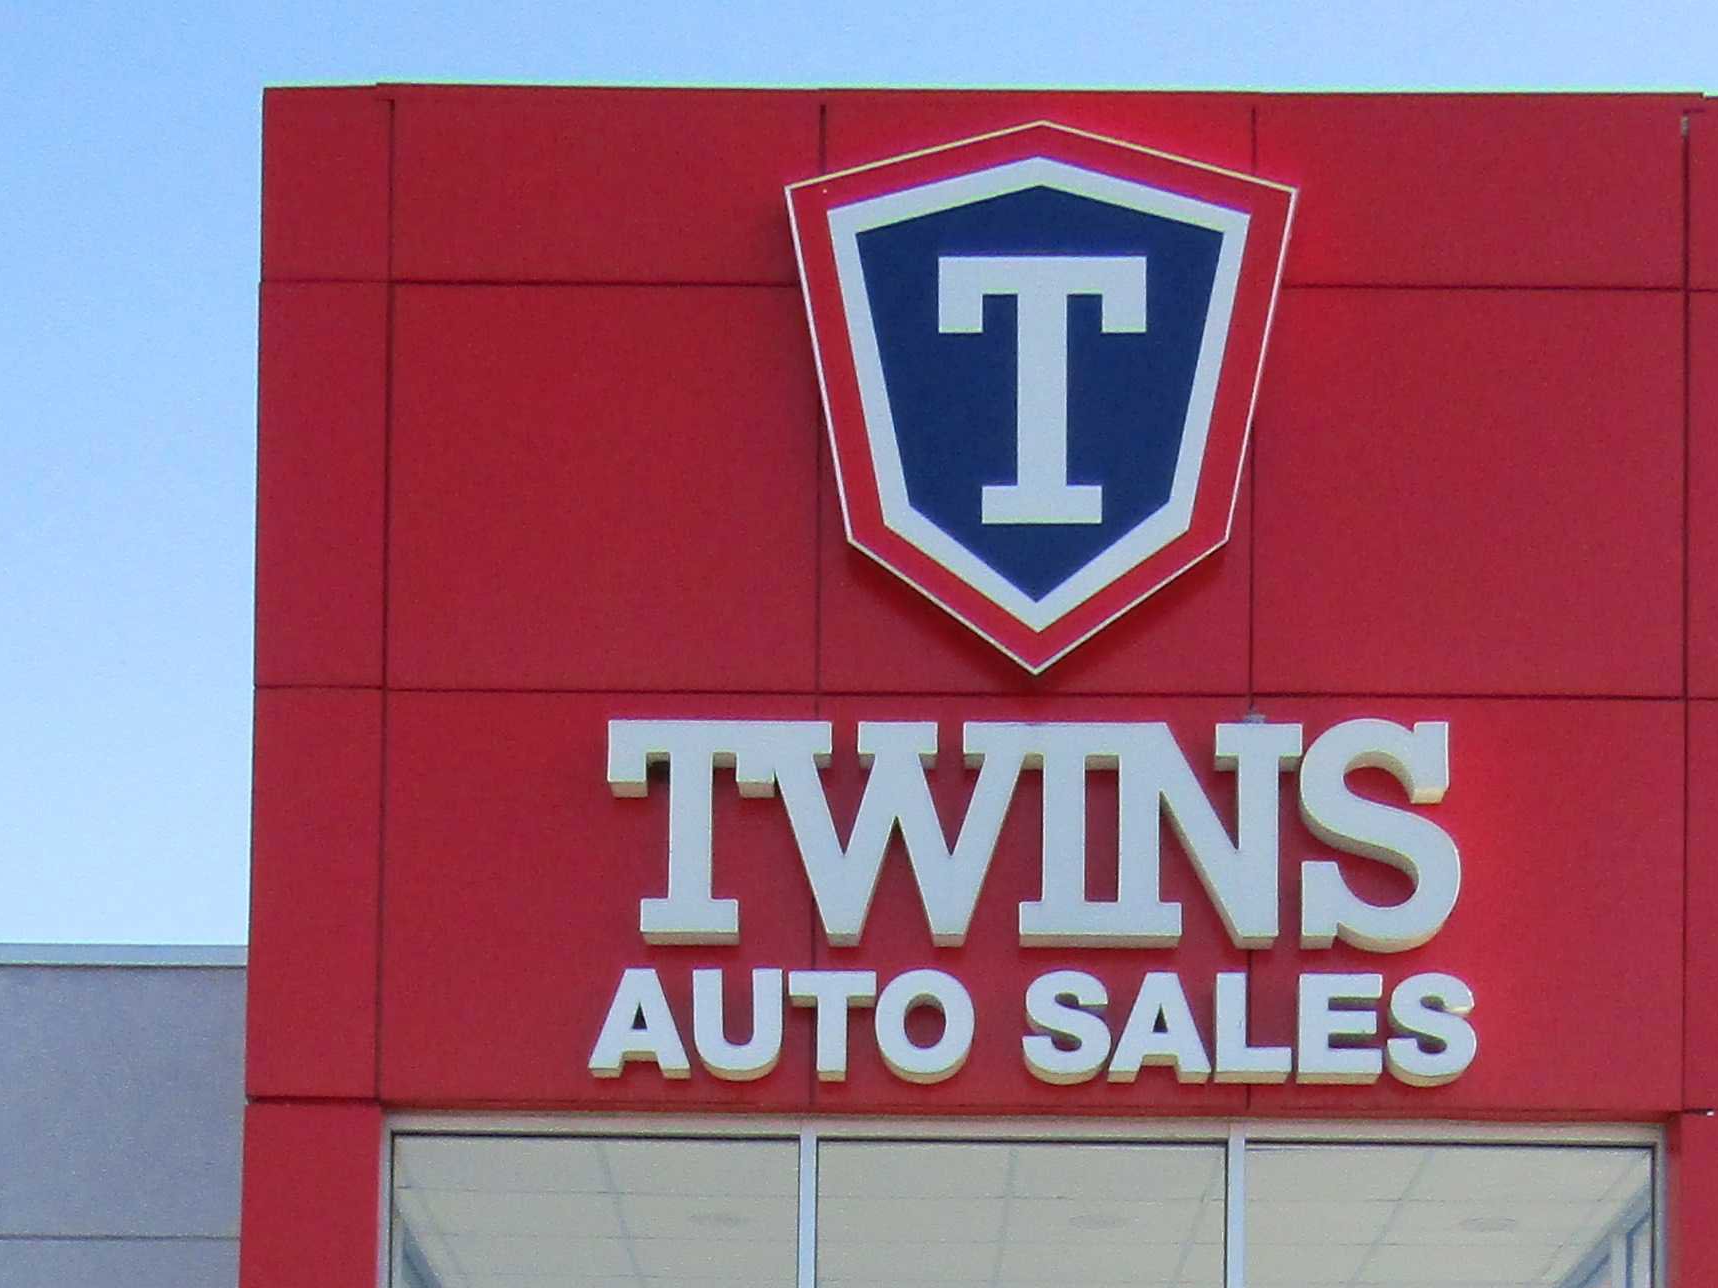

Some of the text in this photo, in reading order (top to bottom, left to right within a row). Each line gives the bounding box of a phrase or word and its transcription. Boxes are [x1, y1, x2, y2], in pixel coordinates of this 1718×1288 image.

[938, 255, 1147, 525] T
[607, 718, 1461, 954] TWINS
[588, 968, 1477, 1087] AUTO SALES
